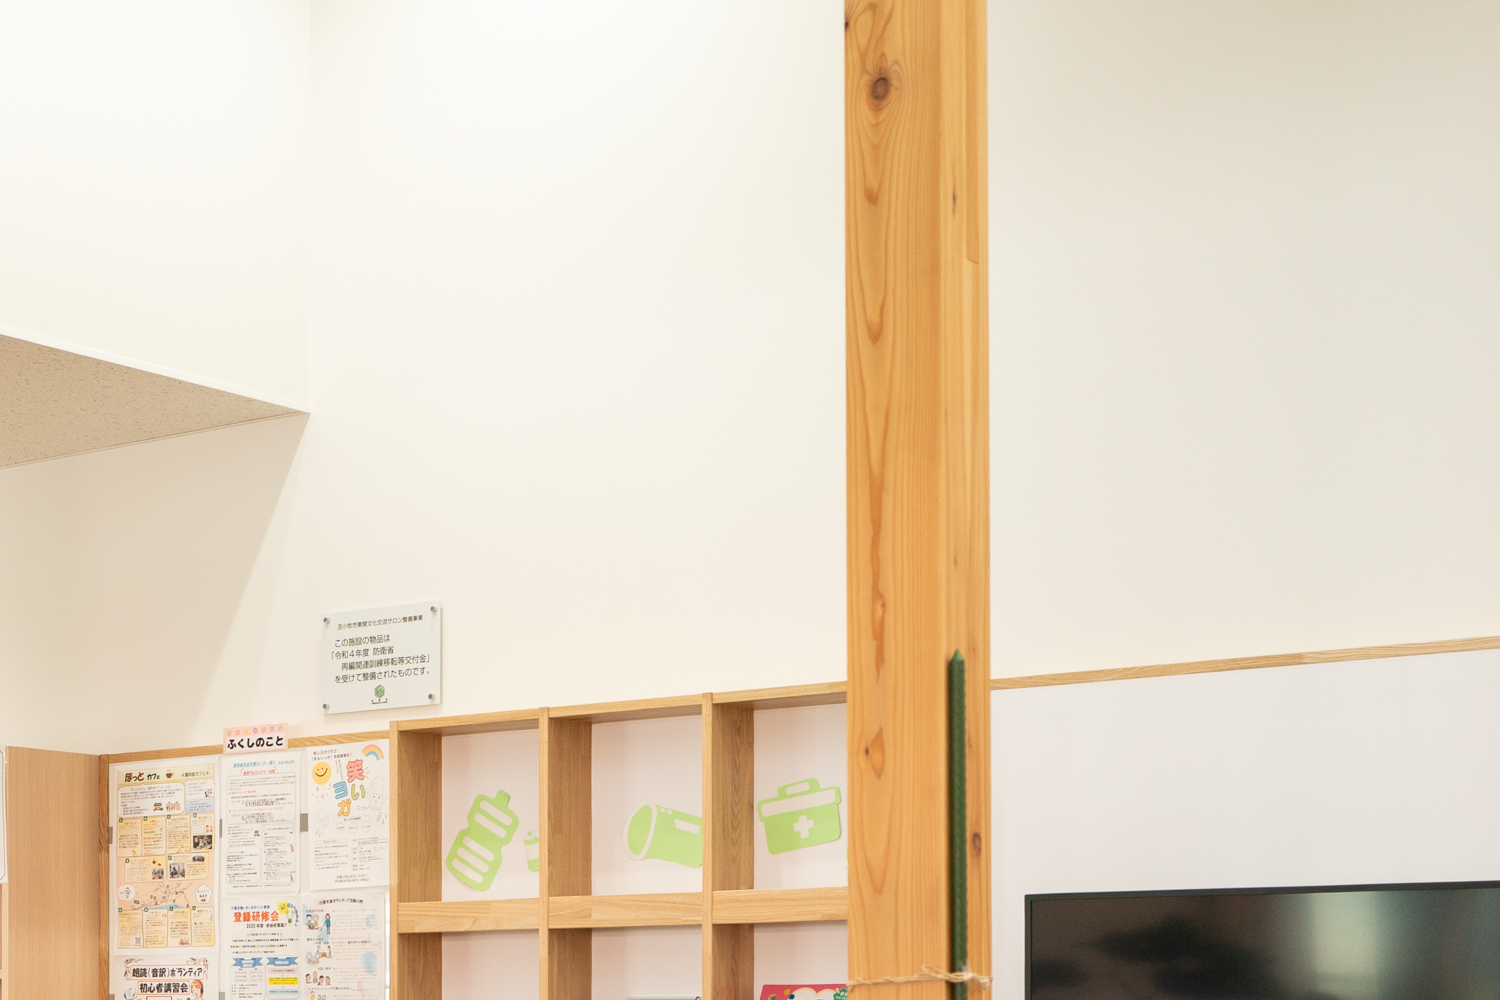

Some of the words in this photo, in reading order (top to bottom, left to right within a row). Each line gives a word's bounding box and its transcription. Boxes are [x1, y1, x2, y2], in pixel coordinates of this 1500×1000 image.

[335, 634, 390, 647] この施設の物品は
[331, 648, 369, 660] 「令和4年度
[373, 646, 394, 656] 防衛省
[335, 667, 430, 684] を受けて整備されたものです。
[227, 736, 283, 750] ふくしのこと
[124, 772, 145, 782] ほっと
[233, 911, 280, 923] 登録研修会
[132, 967, 203, 978] 朗読（音訳）ボランティア
[139, 982, 188, 993] 初心者講習会
